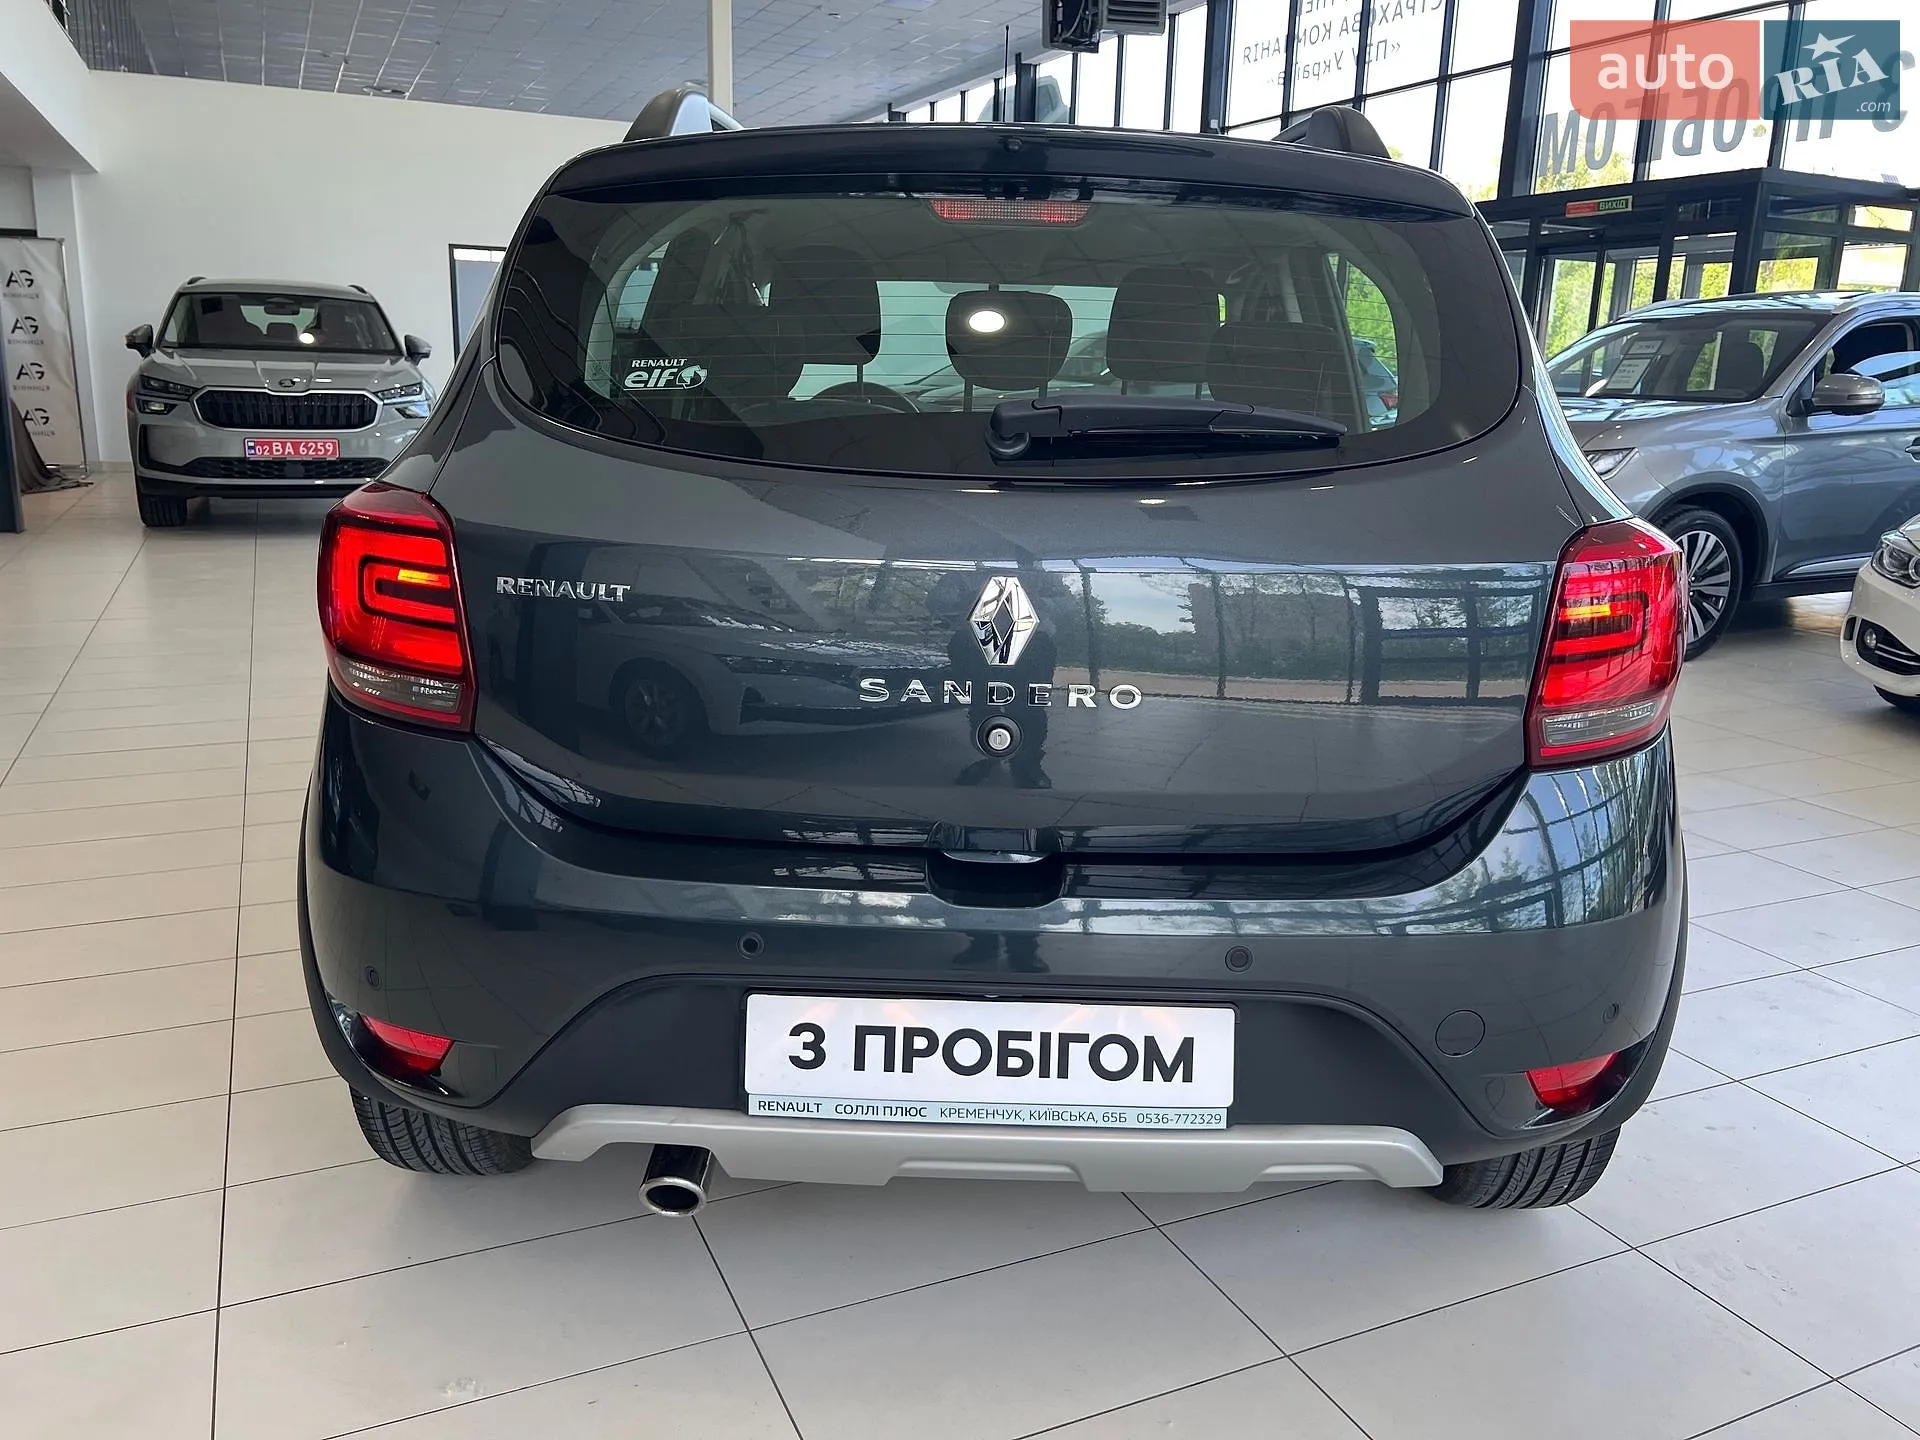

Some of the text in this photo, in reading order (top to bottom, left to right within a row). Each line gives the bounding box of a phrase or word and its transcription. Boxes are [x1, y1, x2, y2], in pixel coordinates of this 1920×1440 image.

[1599, 199, 1626, 211] ВИХІД
[631, 358, 687, 368] RENAULT
[624, 368, 678, 388] elf
[255, 445, 270, 455] 02
[300, 442, 334, 455] 6259
[496, 576, 631, 602] RENAULT
[859, 678, 1143, 710] SANDERO
[853, 1024, 1195, 1083] ПРОБІГОМ
[757, 1100, 1222, 1125] RENAULT СОЛЛІ ПЛЮС КРЕМЕНЧУК, КИЇВСЬКА, 65Б 0536-772329
